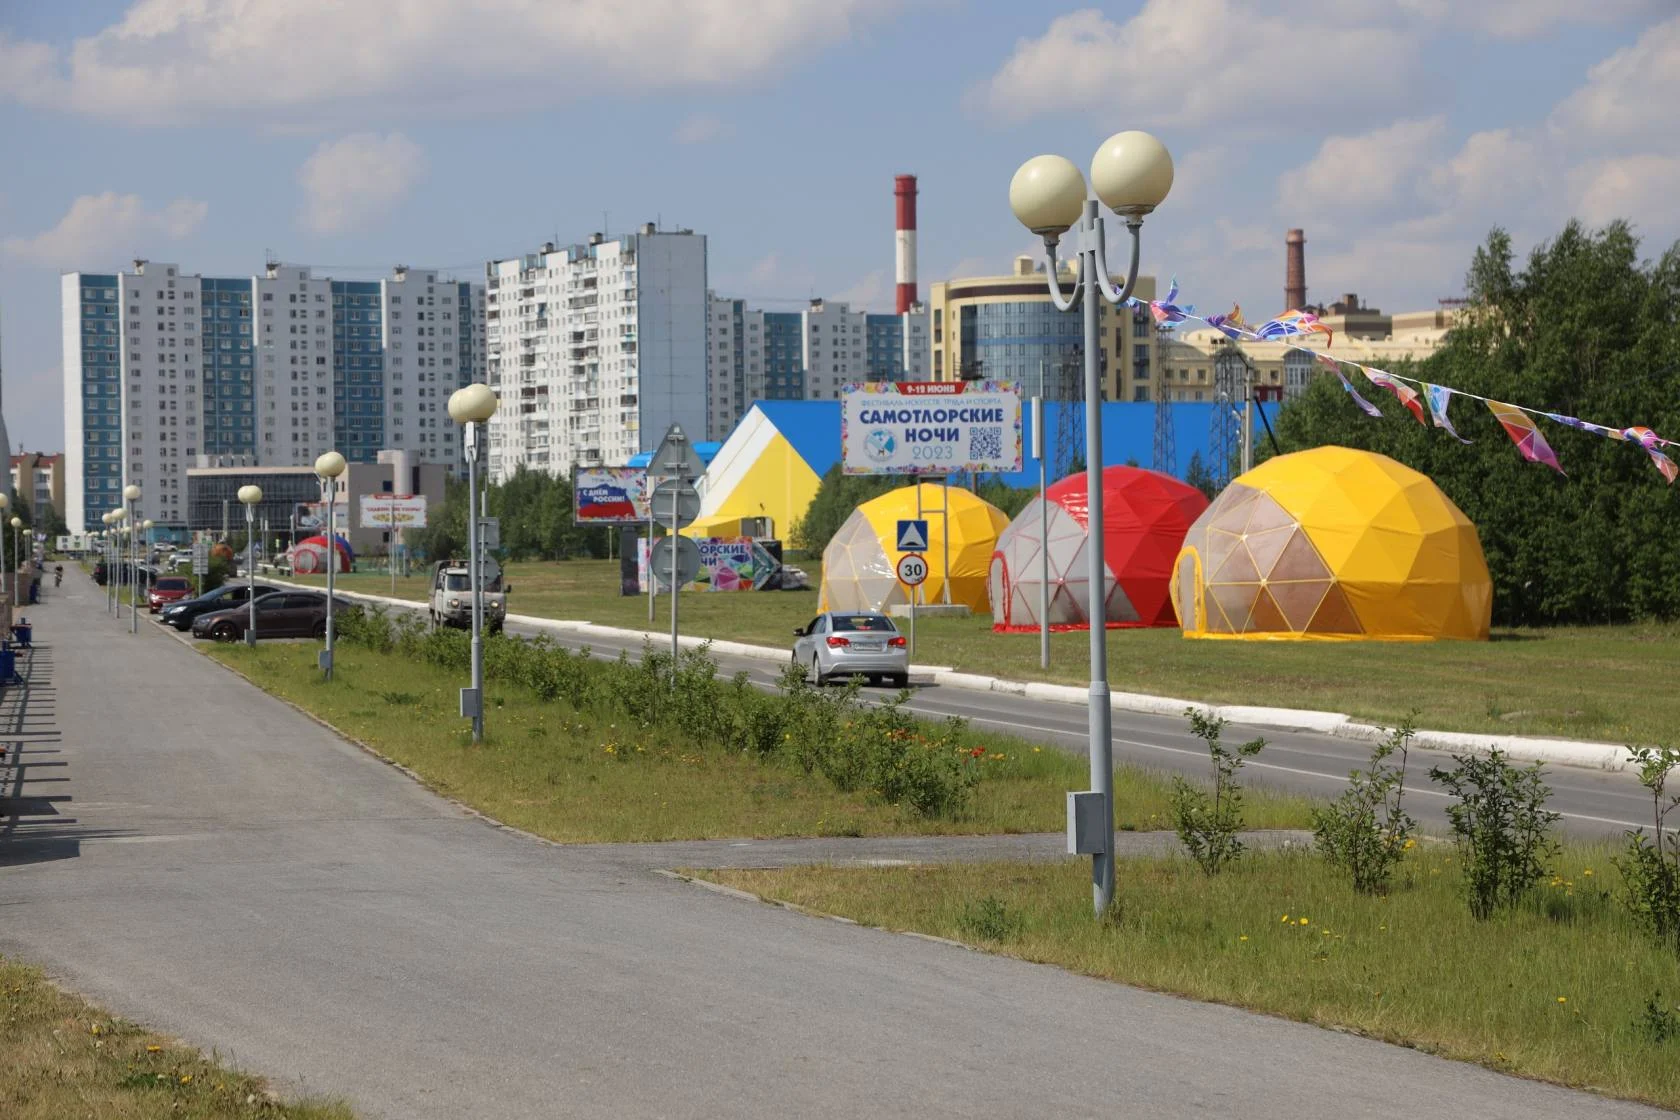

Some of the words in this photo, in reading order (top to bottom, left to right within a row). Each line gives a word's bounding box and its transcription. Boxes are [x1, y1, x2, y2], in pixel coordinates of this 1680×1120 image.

[927, 384, 956, 394] ИЮНЯ
[859, 409, 1004, 425] САМОТЛОРСКИЕ
[905, 427, 960, 443] НОЧИ
[912, 445, 953, 460] 2023
[700, 544, 745, 554] ОРСКИЕ
[701, 556, 717, 566] ЧИ
[905, 564, 922, 577] 30
